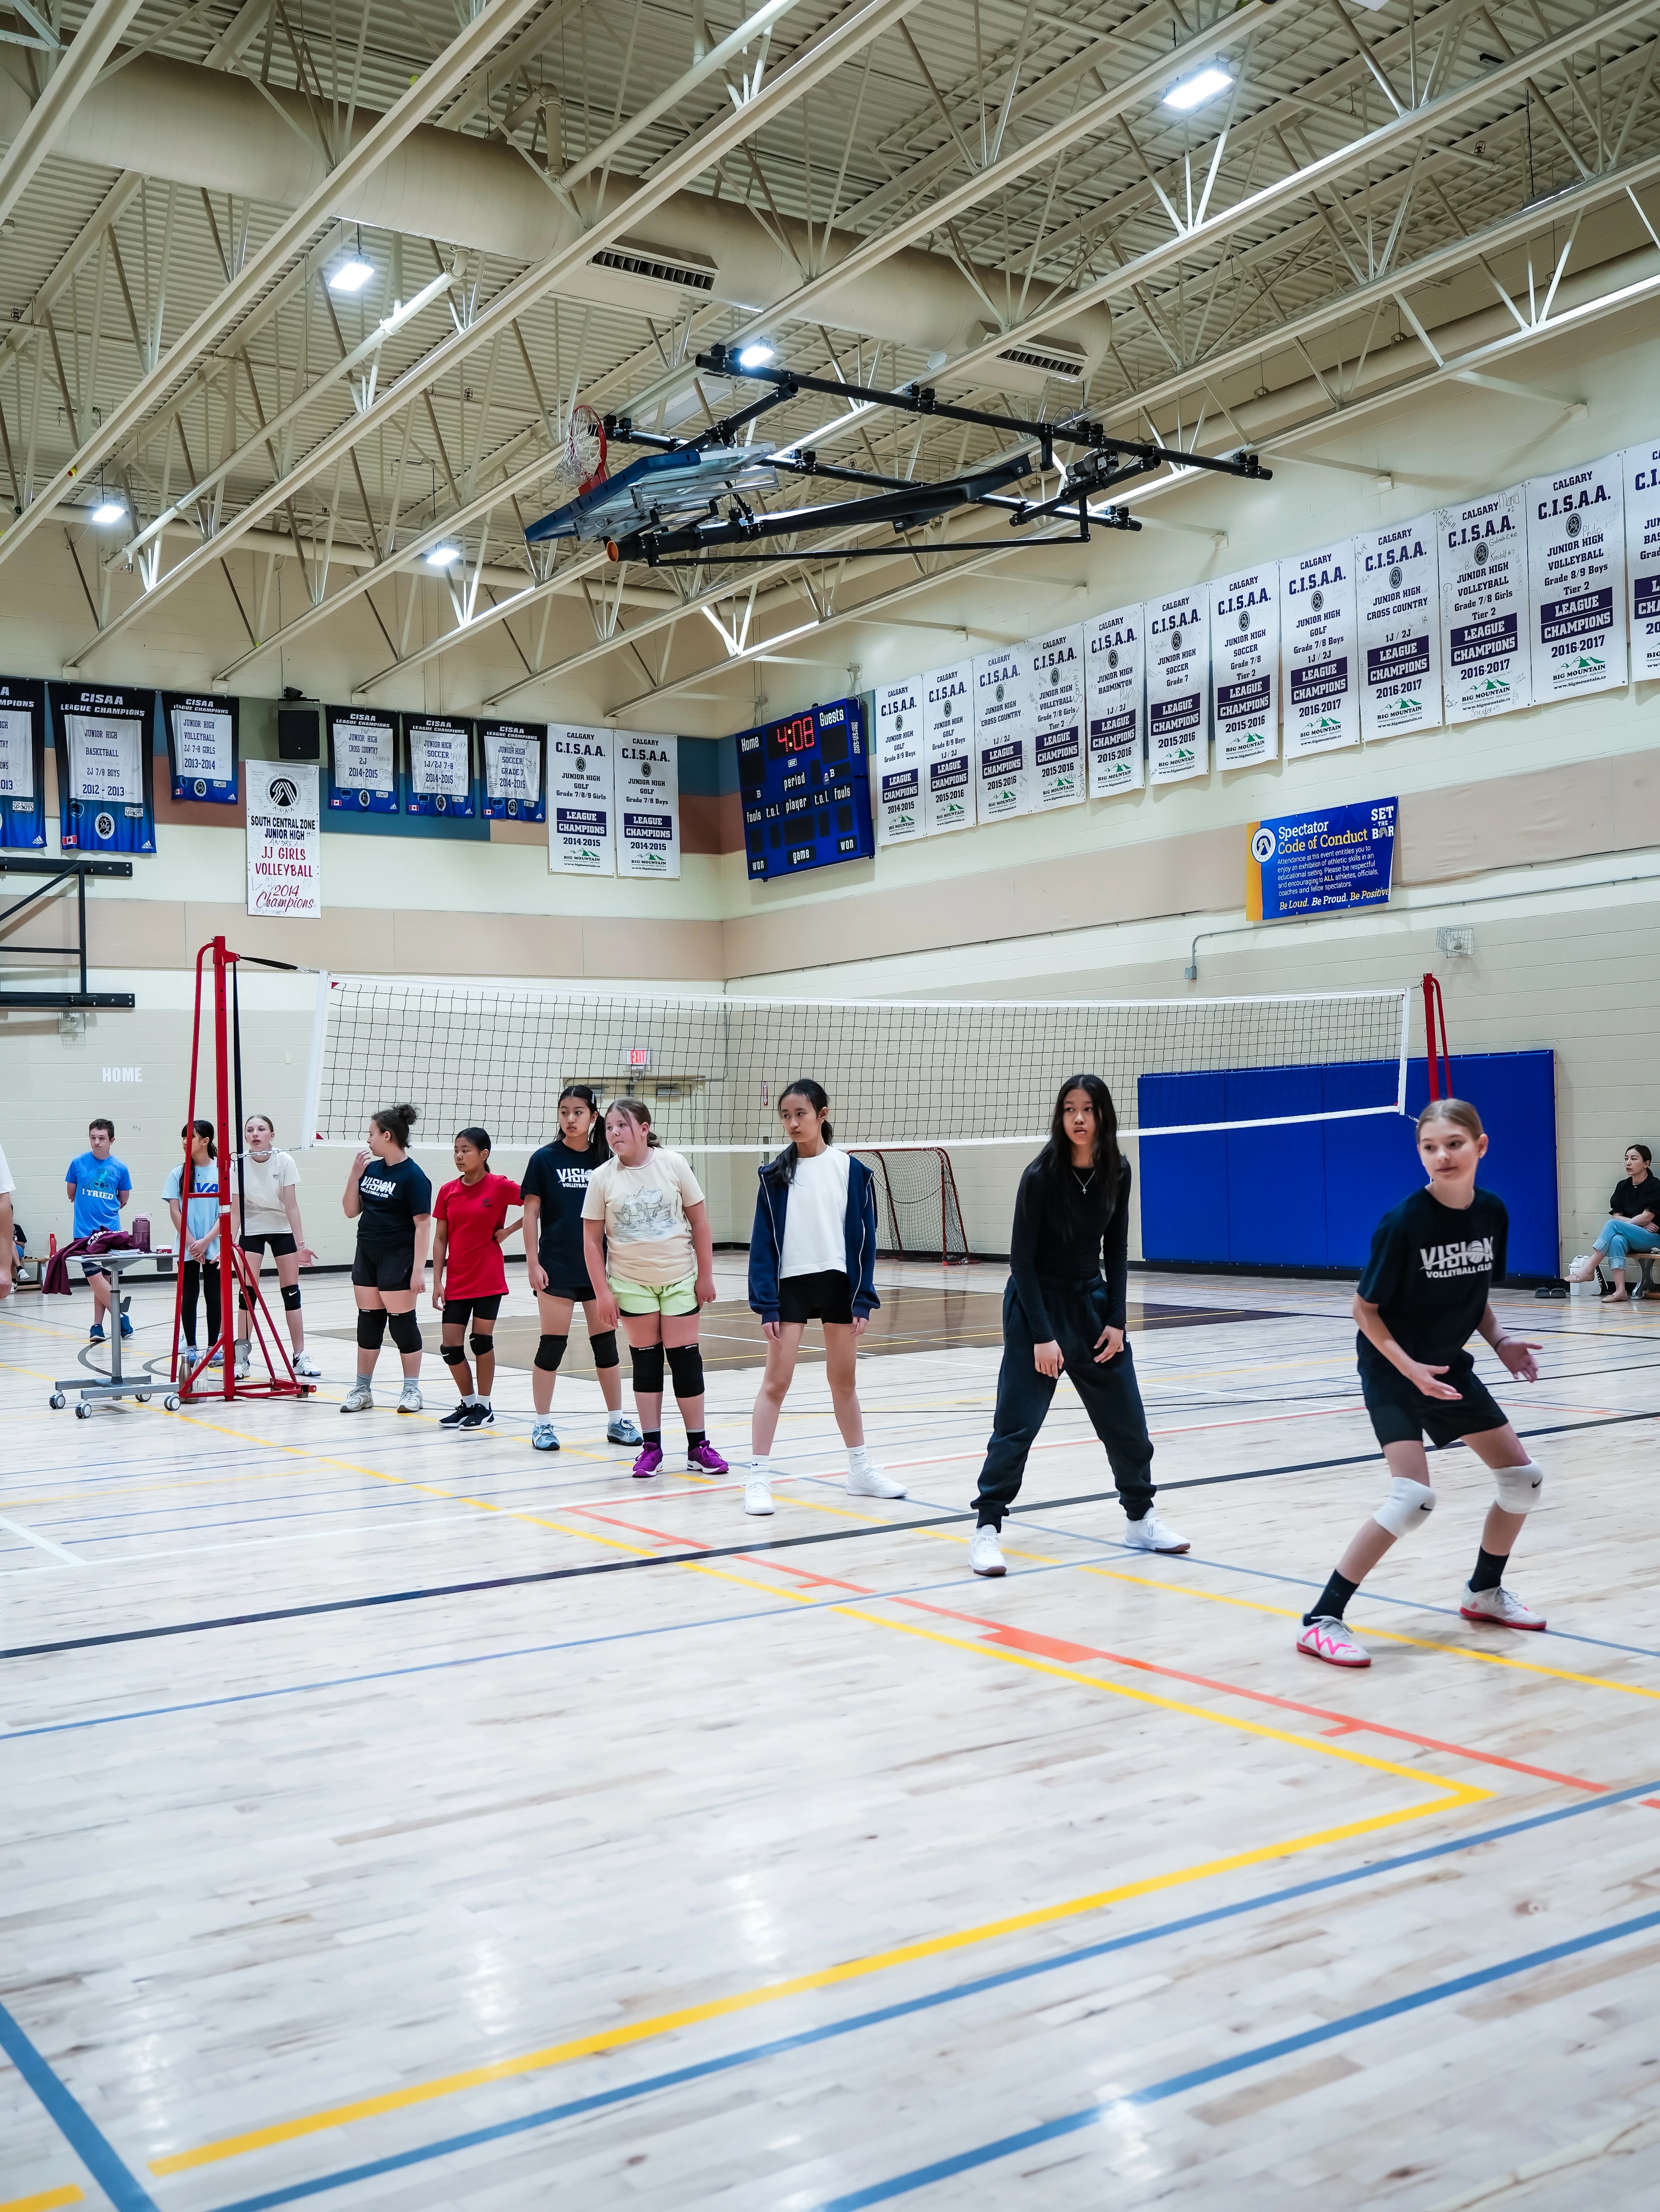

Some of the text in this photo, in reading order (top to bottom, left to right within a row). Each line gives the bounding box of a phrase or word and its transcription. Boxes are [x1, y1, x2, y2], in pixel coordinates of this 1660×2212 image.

[1553, 471, 1593, 491] CALGARY
[1462, 502, 1498, 521] CALGARY
[1538, 485, 1611, 521] C.I.S.A.A.
[1378, 529, 1411, 545] CALGARY
[1448, 515, 1515, 549] C.I.S.A.A.
[1300, 554, 1331, 570] CALGARY
[1366, 541, 1427, 572] C.I.S.A.A.
[1548, 548, 1603, 571] VOLLEYBALL
[1289, 566, 1346, 596] C.I.S.A.A.
[1458, 576, 1509, 597] VOLLEYBALL
[1218, 588, 1271, 616] C.I.S.A.A.
[1367, 598, 1427, 621] CROSS COUNTRY
[1555, 595, 1599, 617] LEAGUE
[1152, 608, 1201, 635] C.I.S.A.A.
[1544, 612, 1610, 639] CHAMPIONS
[1092, 628, 1137, 654] C.I.S.A.A.
[1551, 634, 1605, 658] 2016-2017
[1034, 647, 1077, 671] C.I.S.A.A.
[980, 664, 1020, 687] C.I.S.A.A.
[1166, 663, 1188, 675] SOCCER
[1302, 664, 1337, 681] LEAGUE
[1460, 659, 1510, 681] 2016-2017
[1098, 679, 1132, 694] BADMINTON
[1230, 681, 1262, 698] LEAGUE
[1293, 679, 1346, 700] CHAMPIONS
[1554, 675, 1606, 690] www.bigmountain.ca
[81, 693, 123, 706] CISAA
[929, 681, 967, 703] C.I.S.A.A.
[61, 704, 145, 716] LEAGUE CHAMPIONS
[185, 699, 214, 707] CISAA
[881, 697, 916, 716] C.I.S.A.A.
[1040, 696, 1073, 710] VOLLEYBALL
[1220, 696, 1268, 716] CHAMPIONS
[1299, 699, 1341, 717] 2016-2017
[1463, 697, 1511, 711] www.bigmountain.ca
[819, 707, 844, 727] Guests
[981, 710, 1021, 727] CROSS COUNTRY
[1226, 716, 1265, 733] 2015-2016
[184, 733, 215, 742] VOLLEYBALL
[777, 716, 815, 752] 4:08
[1044, 732, 1070, 746] LEAGUE
[1301, 734, 1341, 746] www.bigmountain.ca
[86, 747, 118, 758] BASKETBALL
[348, 745, 378, 754] CROSS COUNTRY
[556, 742, 606, 757] C.I.S.A.A.
[741, 736, 759, 752] Home
[428, 750, 449, 758] SOCCER
[502, 756, 524, 765] SOCCER
[622, 748, 670, 762] C.I.S.A.A.
[1038, 745, 1078, 763] CHAMPIONS
[185, 758, 215, 770] 2013-2014
[349, 767, 378, 778] 2014-2015
[1041, 763, 1074, 777] 2015-2016
[266, 774, 278, 788] SCHOOLS
[784, 772, 805, 791] period
[830, 769, 834, 777] B
[747, 785, 850, 823] fouls t.o.l. player t.o.l. fouls
[566, 811, 597, 822] LEAGUE
[1371, 806, 1394, 821] SET
[251, 816, 315, 830] SOUTH CENTRAL ZONE
[559, 824, 605, 834] CHAMPIONS
[1279, 821, 1328, 841] Spectator
[265, 828, 305, 840] JUNIOR HIGH
[563, 837, 601, 847] 2014-2015
[1278, 839, 1305, 854] Code
[1308, 835, 1317, 850] of
[1320, 829, 1368, 848] Conduct
[262, 846, 306, 860] JJ GIRLS
[753, 839, 853, 871] won game won
[1277, 856, 1306, 865] Attendance
[1335, 847, 1354, 856] entitles
[255, 863, 313, 878] VOLLEYBALL
[1278, 871, 1306, 881] educational
[1308, 869, 1323, 877] setting.
[1325, 865, 1341, 873] Please
[1350, 860, 1375, 870] respectful
[1299, 861, 1320, 869] exhibition
[1288, 879, 1318, 887] encouraging
[1358, 869, 1379, 877] officials,
[1325, 882, 1352, 891] spectators.
[273, 885, 299, 897] 2014
[256, 892, 314, 912] Champions
[1280, 902, 1287, 910] Be
[1289, 898, 1309, 908] Loud.
[1312, 897, 1321, 906] Be
[1323, 892, 1348, 905] Proud.
[1350, 892, 1360, 901] Be
[630, 1050, 645, 1063] EXIT
[102, 1067, 143, 1082] HOME
[87, 1189, 114, 1200] TRIED
[361, 1176, 396, 1196] VISION
[361, 1187, 380, 1196] VOLLEYBALL
[1419, 1236, 1494, 1270] VISION
[1426, 1266, 1476, 1279] VOLLEYBALL
